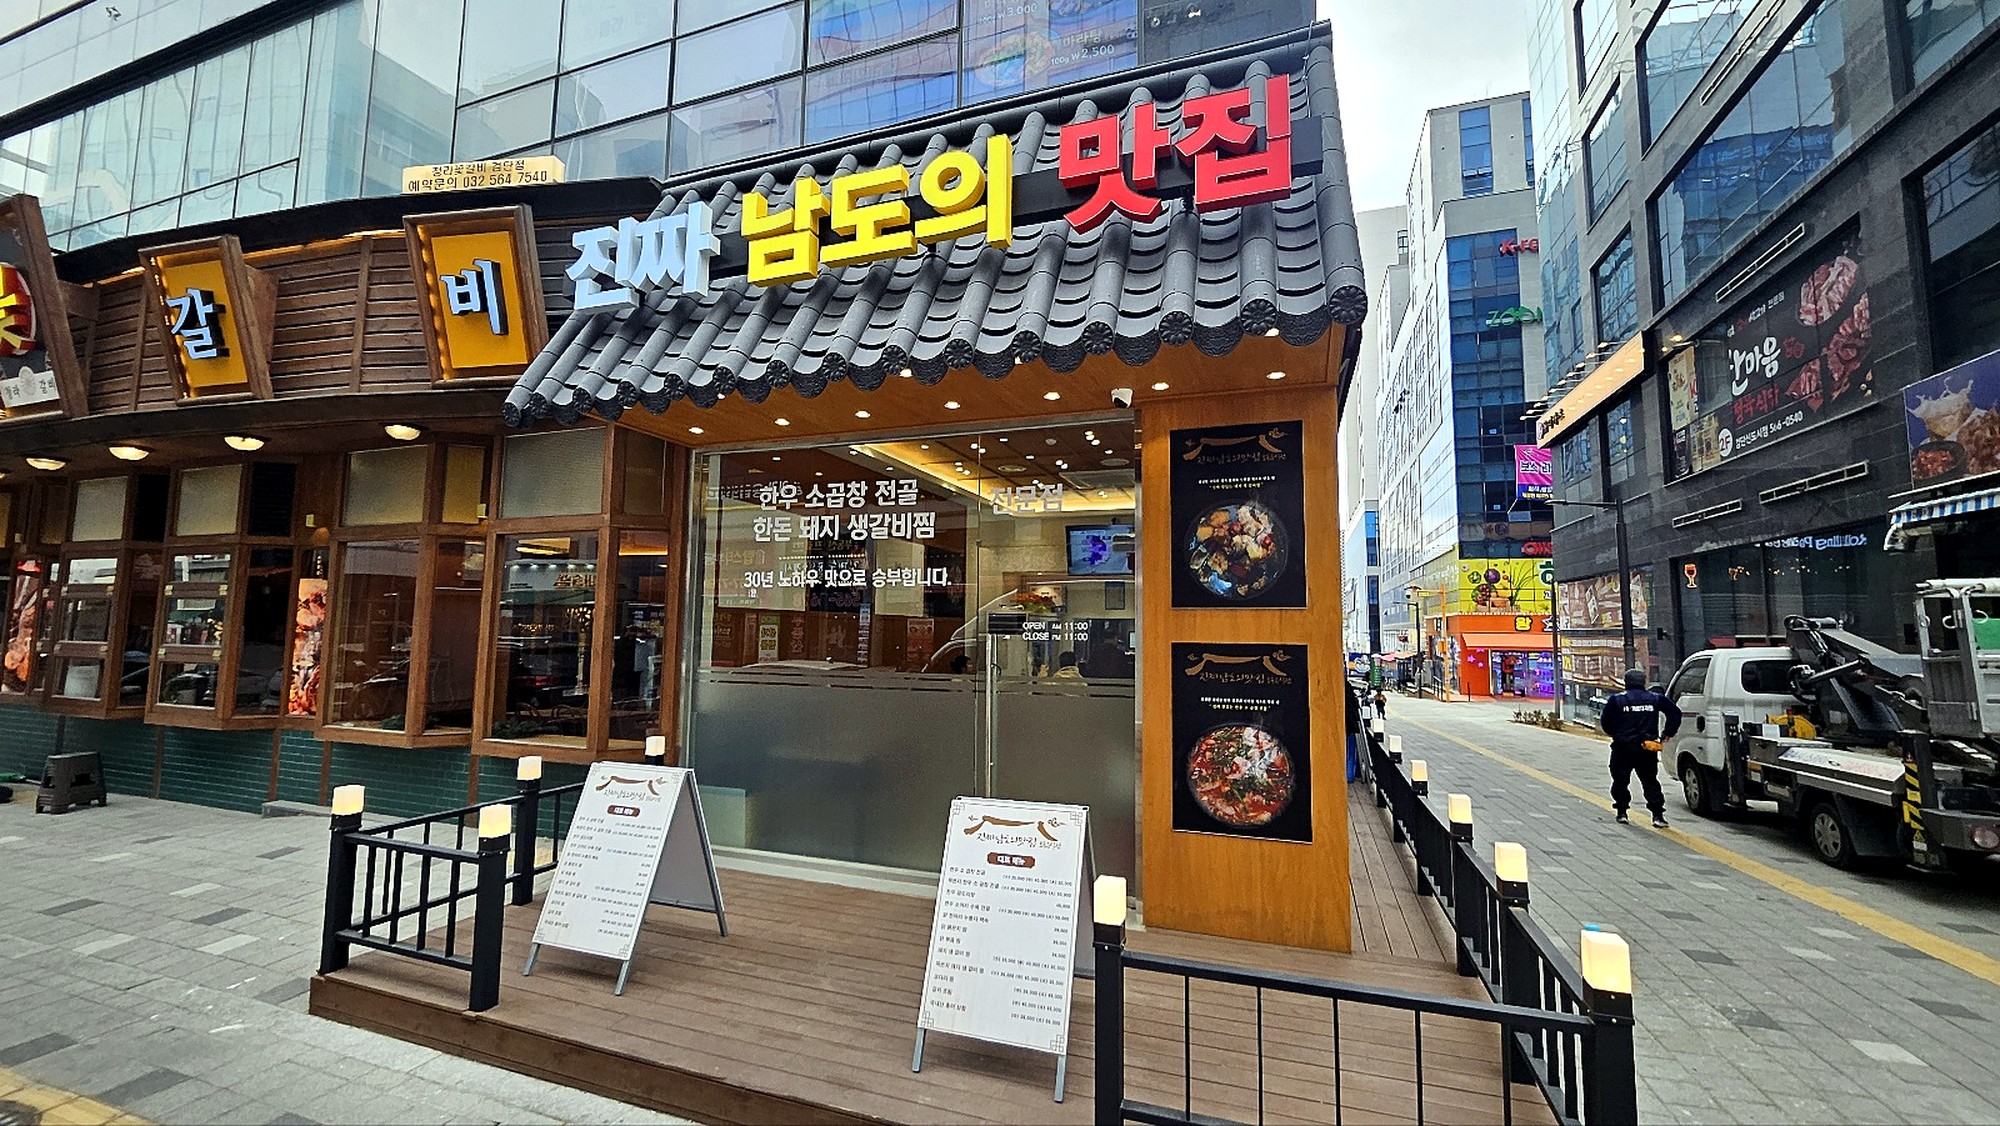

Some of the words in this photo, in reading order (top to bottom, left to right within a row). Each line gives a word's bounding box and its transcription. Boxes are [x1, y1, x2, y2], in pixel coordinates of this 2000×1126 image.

[408, 176, 458, 192] 예약문의
[463, 175, 485, 189] 032
[489, 173, 512, 186] 564
[518, 170, 548, 184] 7540
[566, 200, 721, 313] 진짜
[740, 134, 1014, 286] 남도의
[1057, 74, 1293, 235] 맛집
[166, 287, 226, 360] 갈
[440, 260, 507, 335] 비
[1719, 435, 1731, 452] 2F
[759, 484, 798, 511] 한우
[804, 481, 869, 509] 소곱창
[874, 479, 919, 507] 전골
[989, 483, 1064, 515] 전문점
[753, 516, 793, 542] 한돈
[798, 514, 840, 541] 돼지
[847, 511, 936, 541] 생갈비찜
[743, 570, 774, 588] 30년
[777, 569, 822, 588] 노하우
[824, 568, 867, 588] 맛으로
[872, 567, 952, 588] 승부합니다.
[1022, 622, 1046, 631] OPEN
[1064, 622, 1089, 630] 11:00
[1022, 632, 1050, 641] CLOSE
[1064, 632, 1089, 641] 11:00
